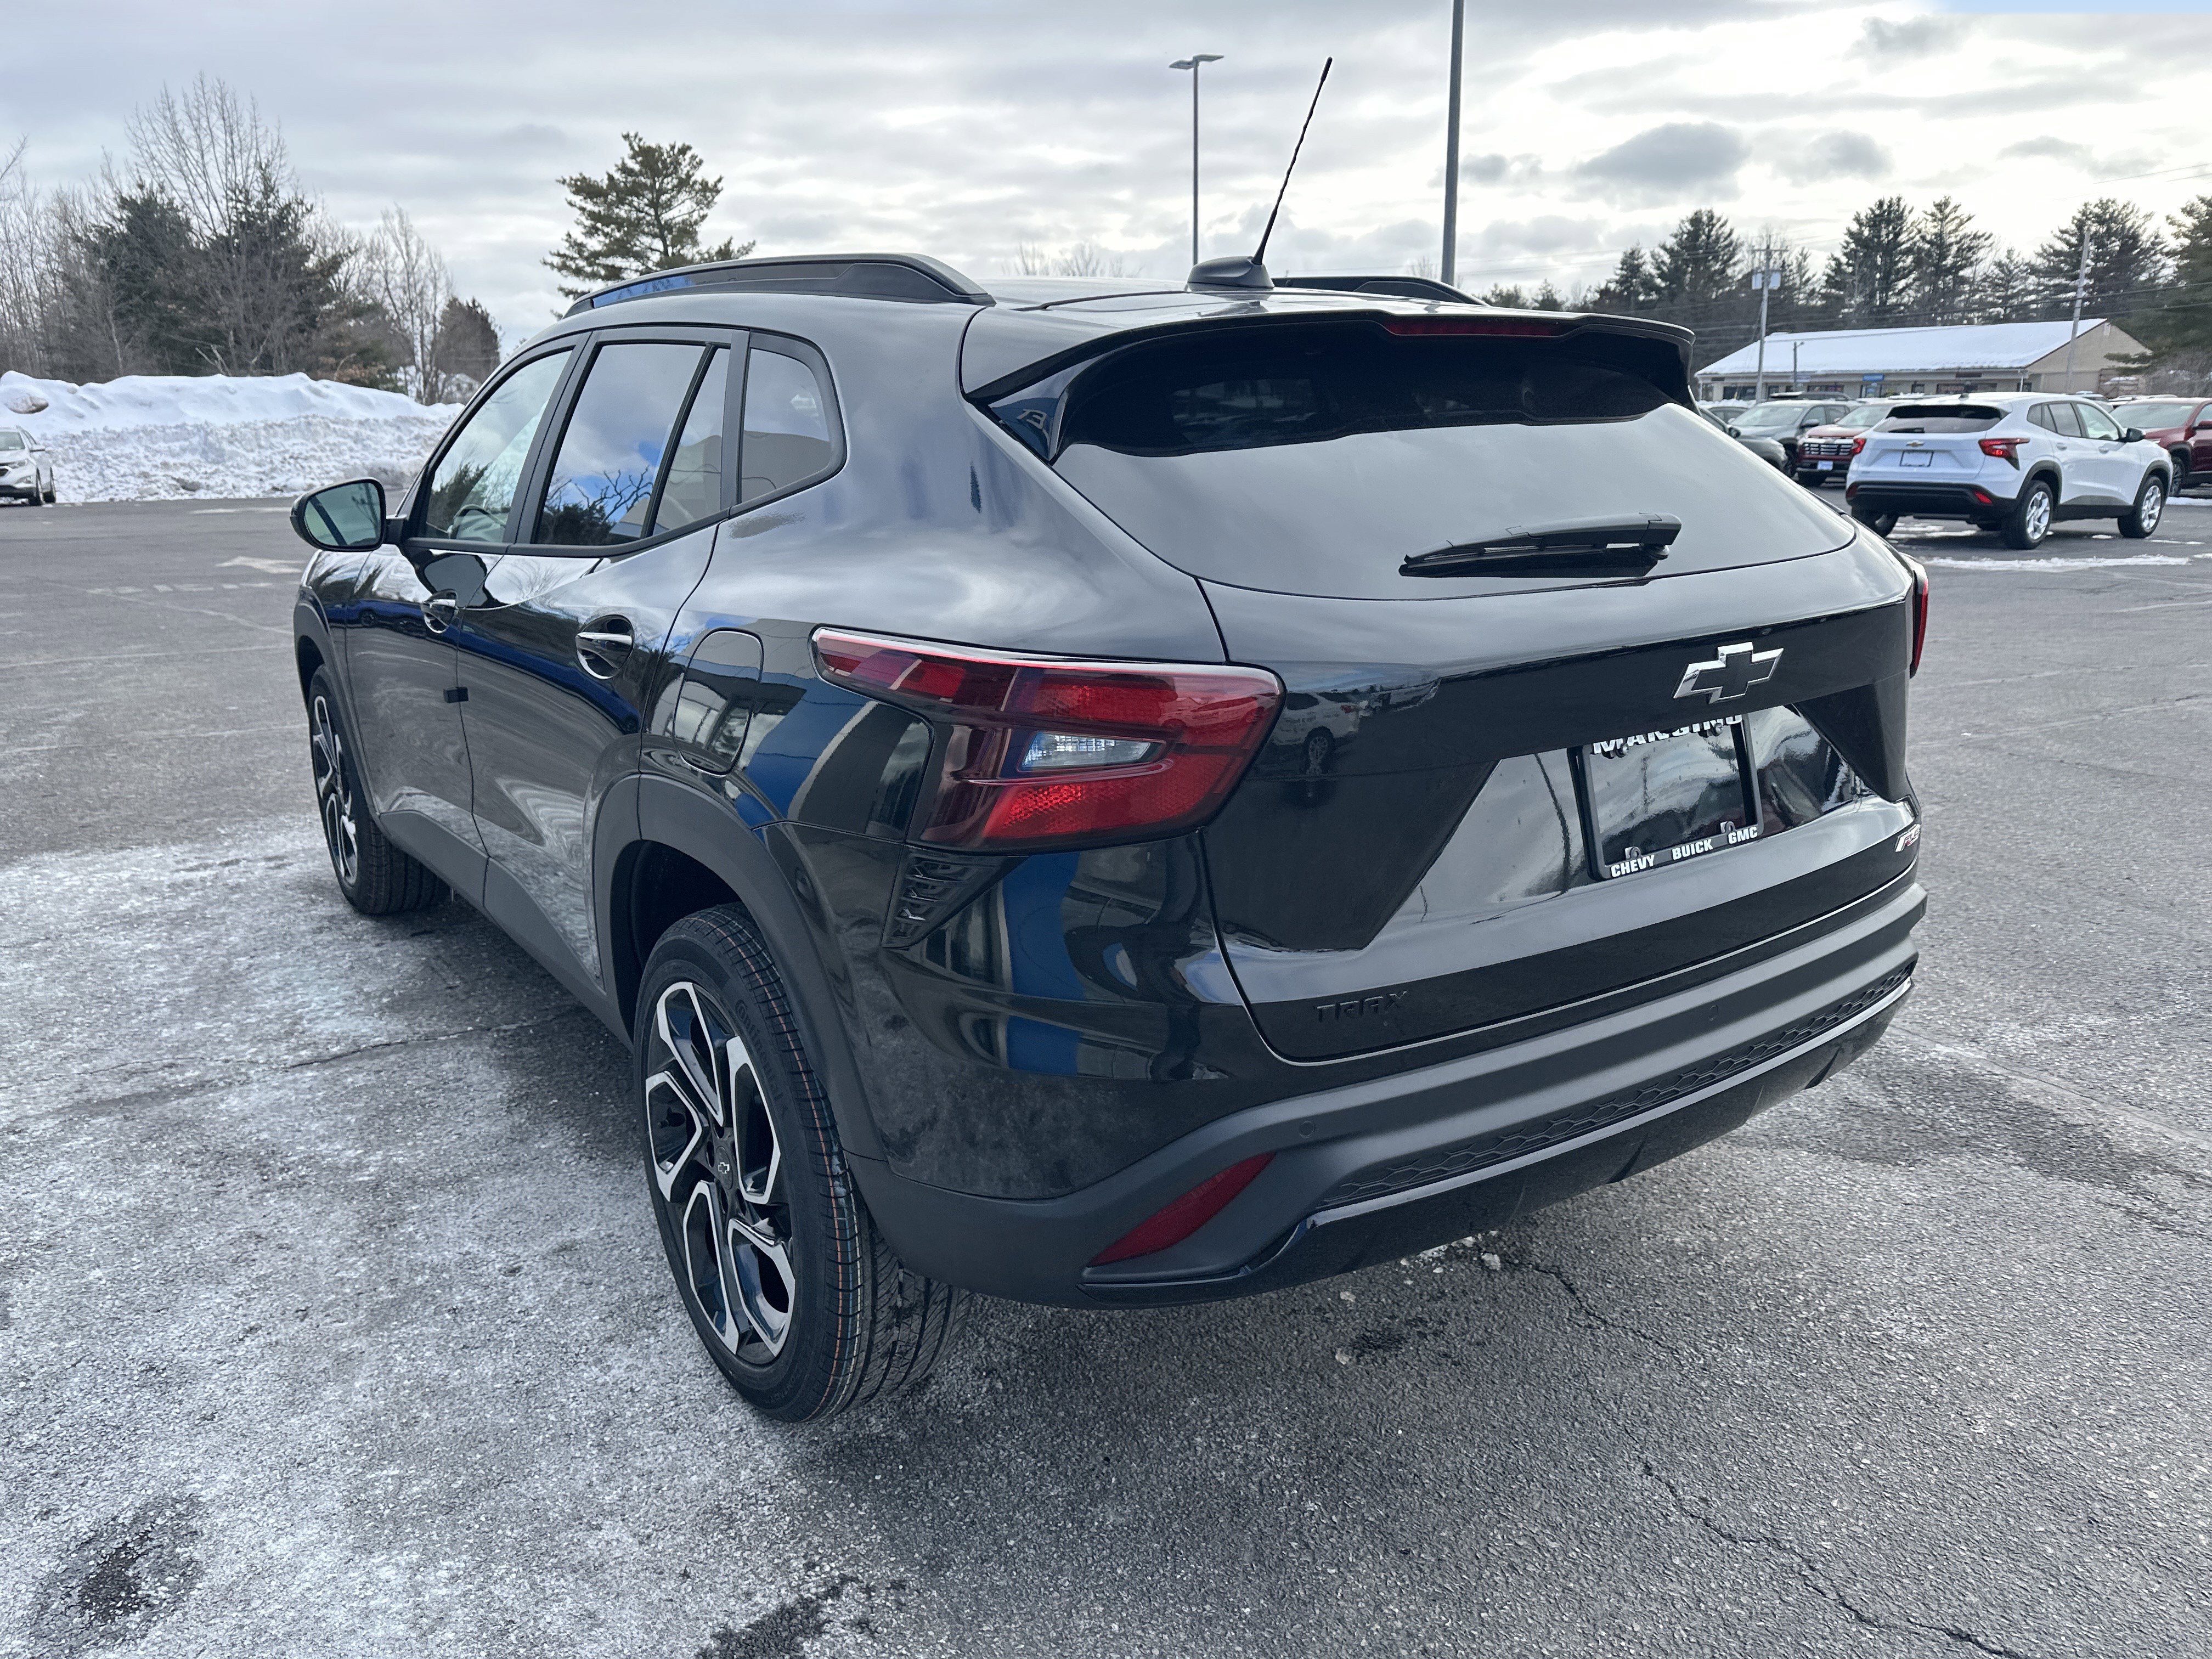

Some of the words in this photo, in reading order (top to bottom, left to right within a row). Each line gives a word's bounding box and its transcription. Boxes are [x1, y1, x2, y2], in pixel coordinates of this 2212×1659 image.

[1611, 854, 1655, 878] CHEVY
[1672, 838, 1713, 860] BUICK
[1728, 826, 1758, 845] GMC
[1313, 990, 1407, 1023] TRAX
